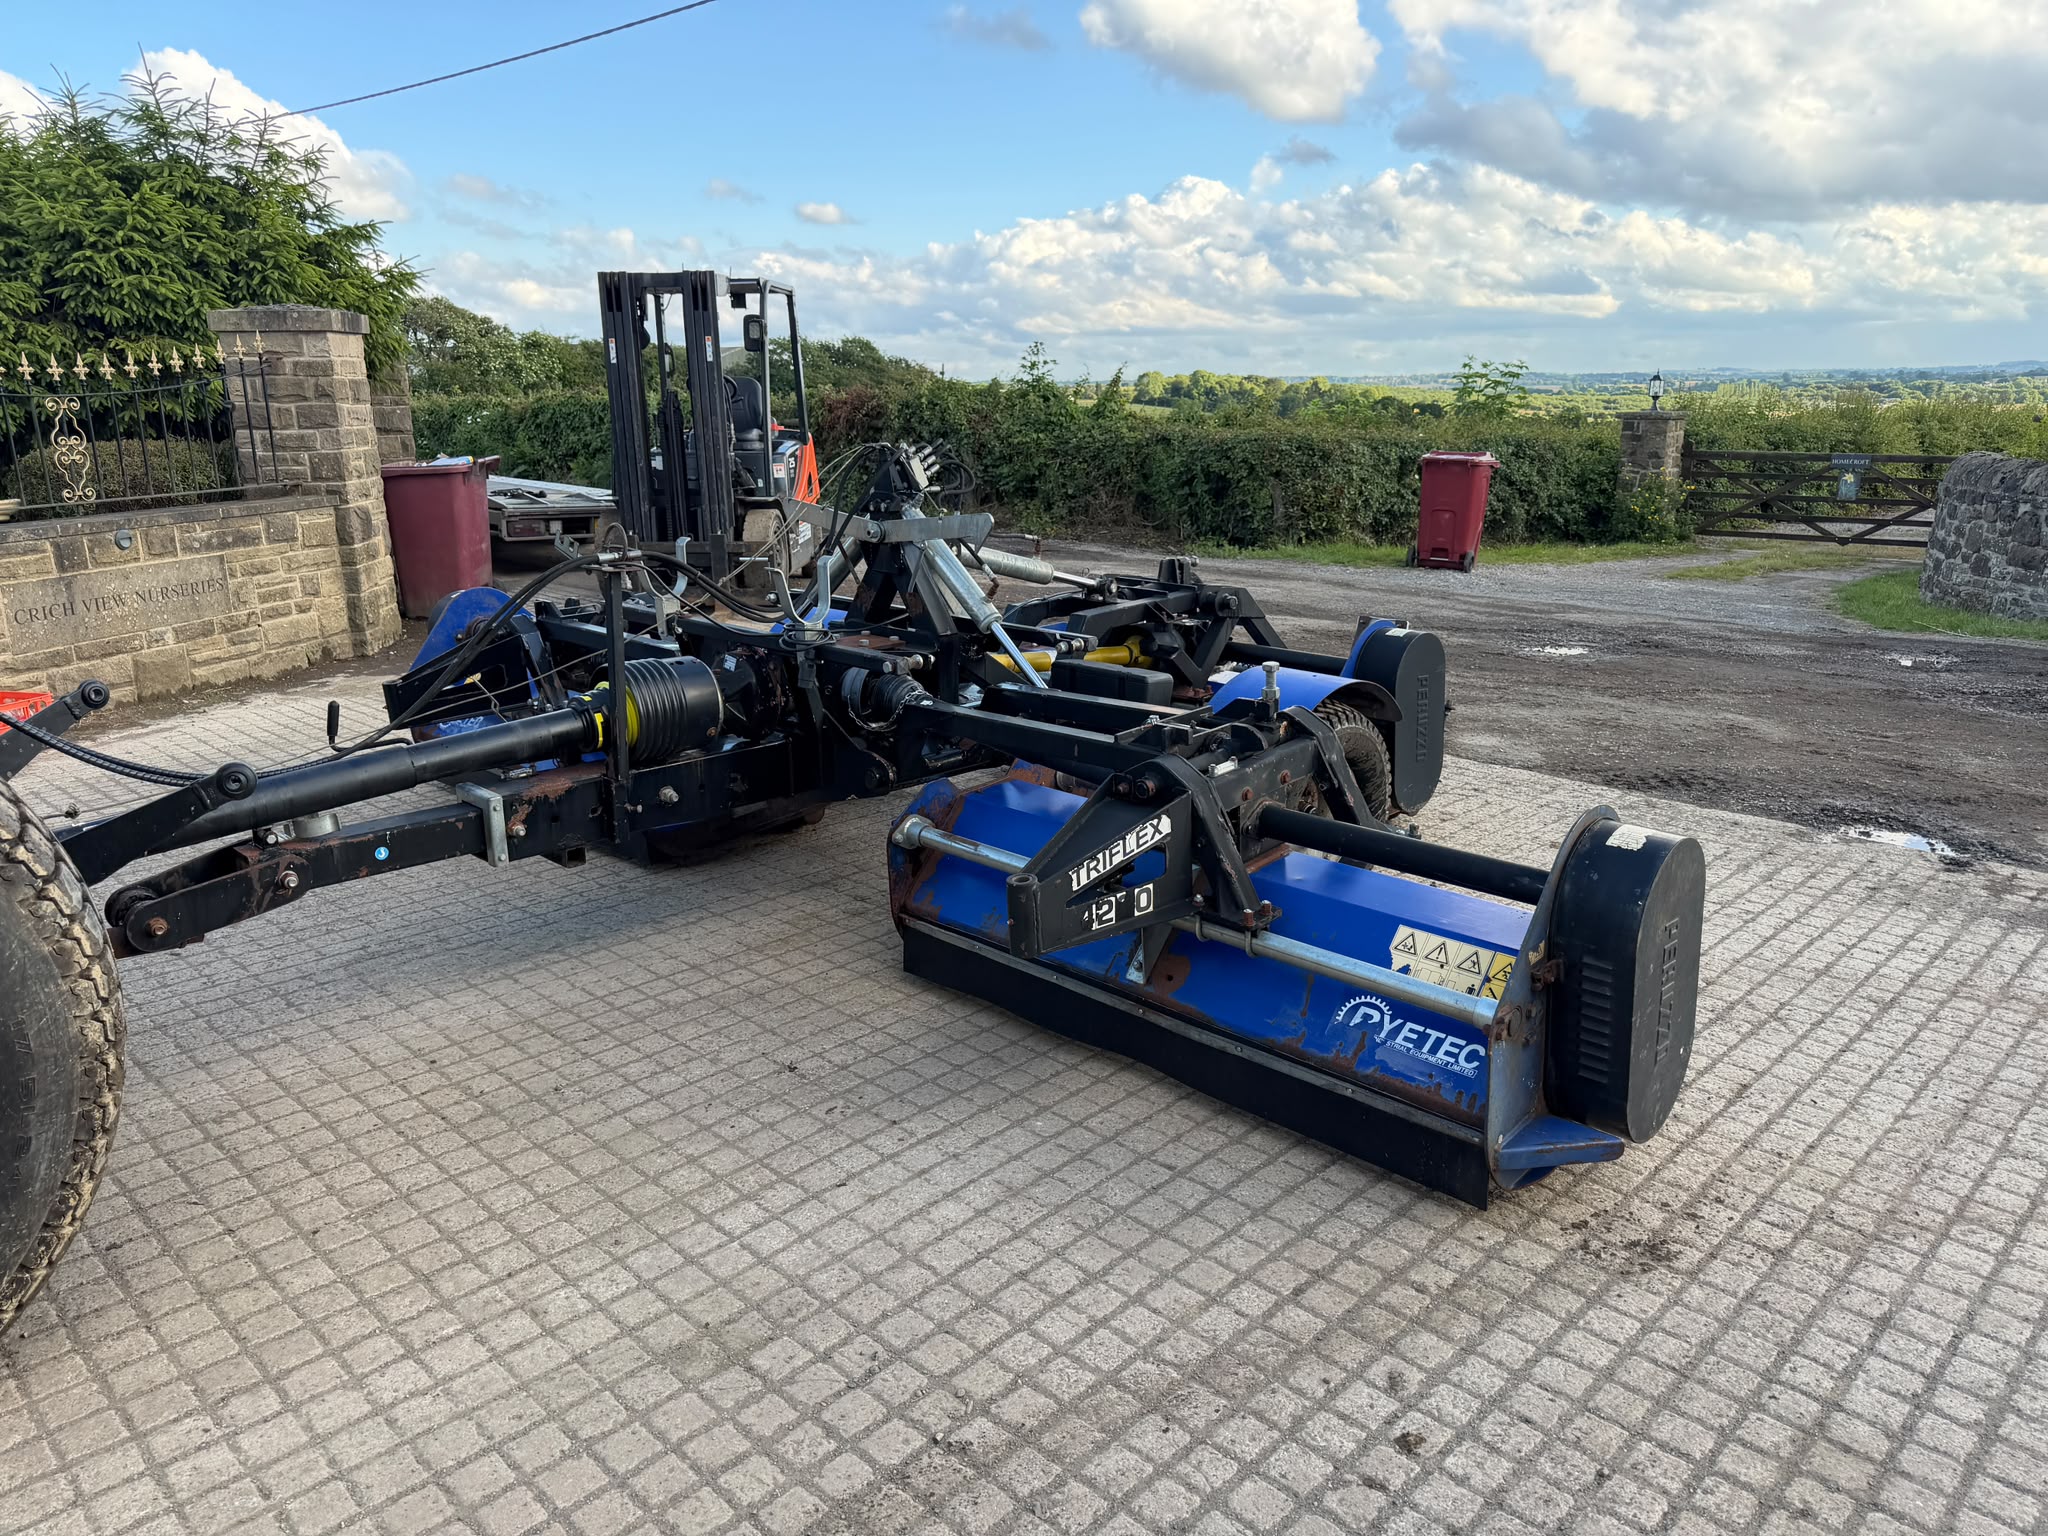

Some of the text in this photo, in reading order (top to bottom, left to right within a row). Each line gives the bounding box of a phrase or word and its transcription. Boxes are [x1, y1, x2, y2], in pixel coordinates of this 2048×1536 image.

[14, 577, 225, 625] CRICH VIEW NURSERIES
[1072, 817, 1164, 888] TRIFLEX
[1082, 885, 1153, 929] 420
[1653, 917, 1679, 1068] PERUZZO
[1409, 1048, 1446, 1067] EQUIPMENT
[1447, 1062, 1475, 1077] LIMITED
